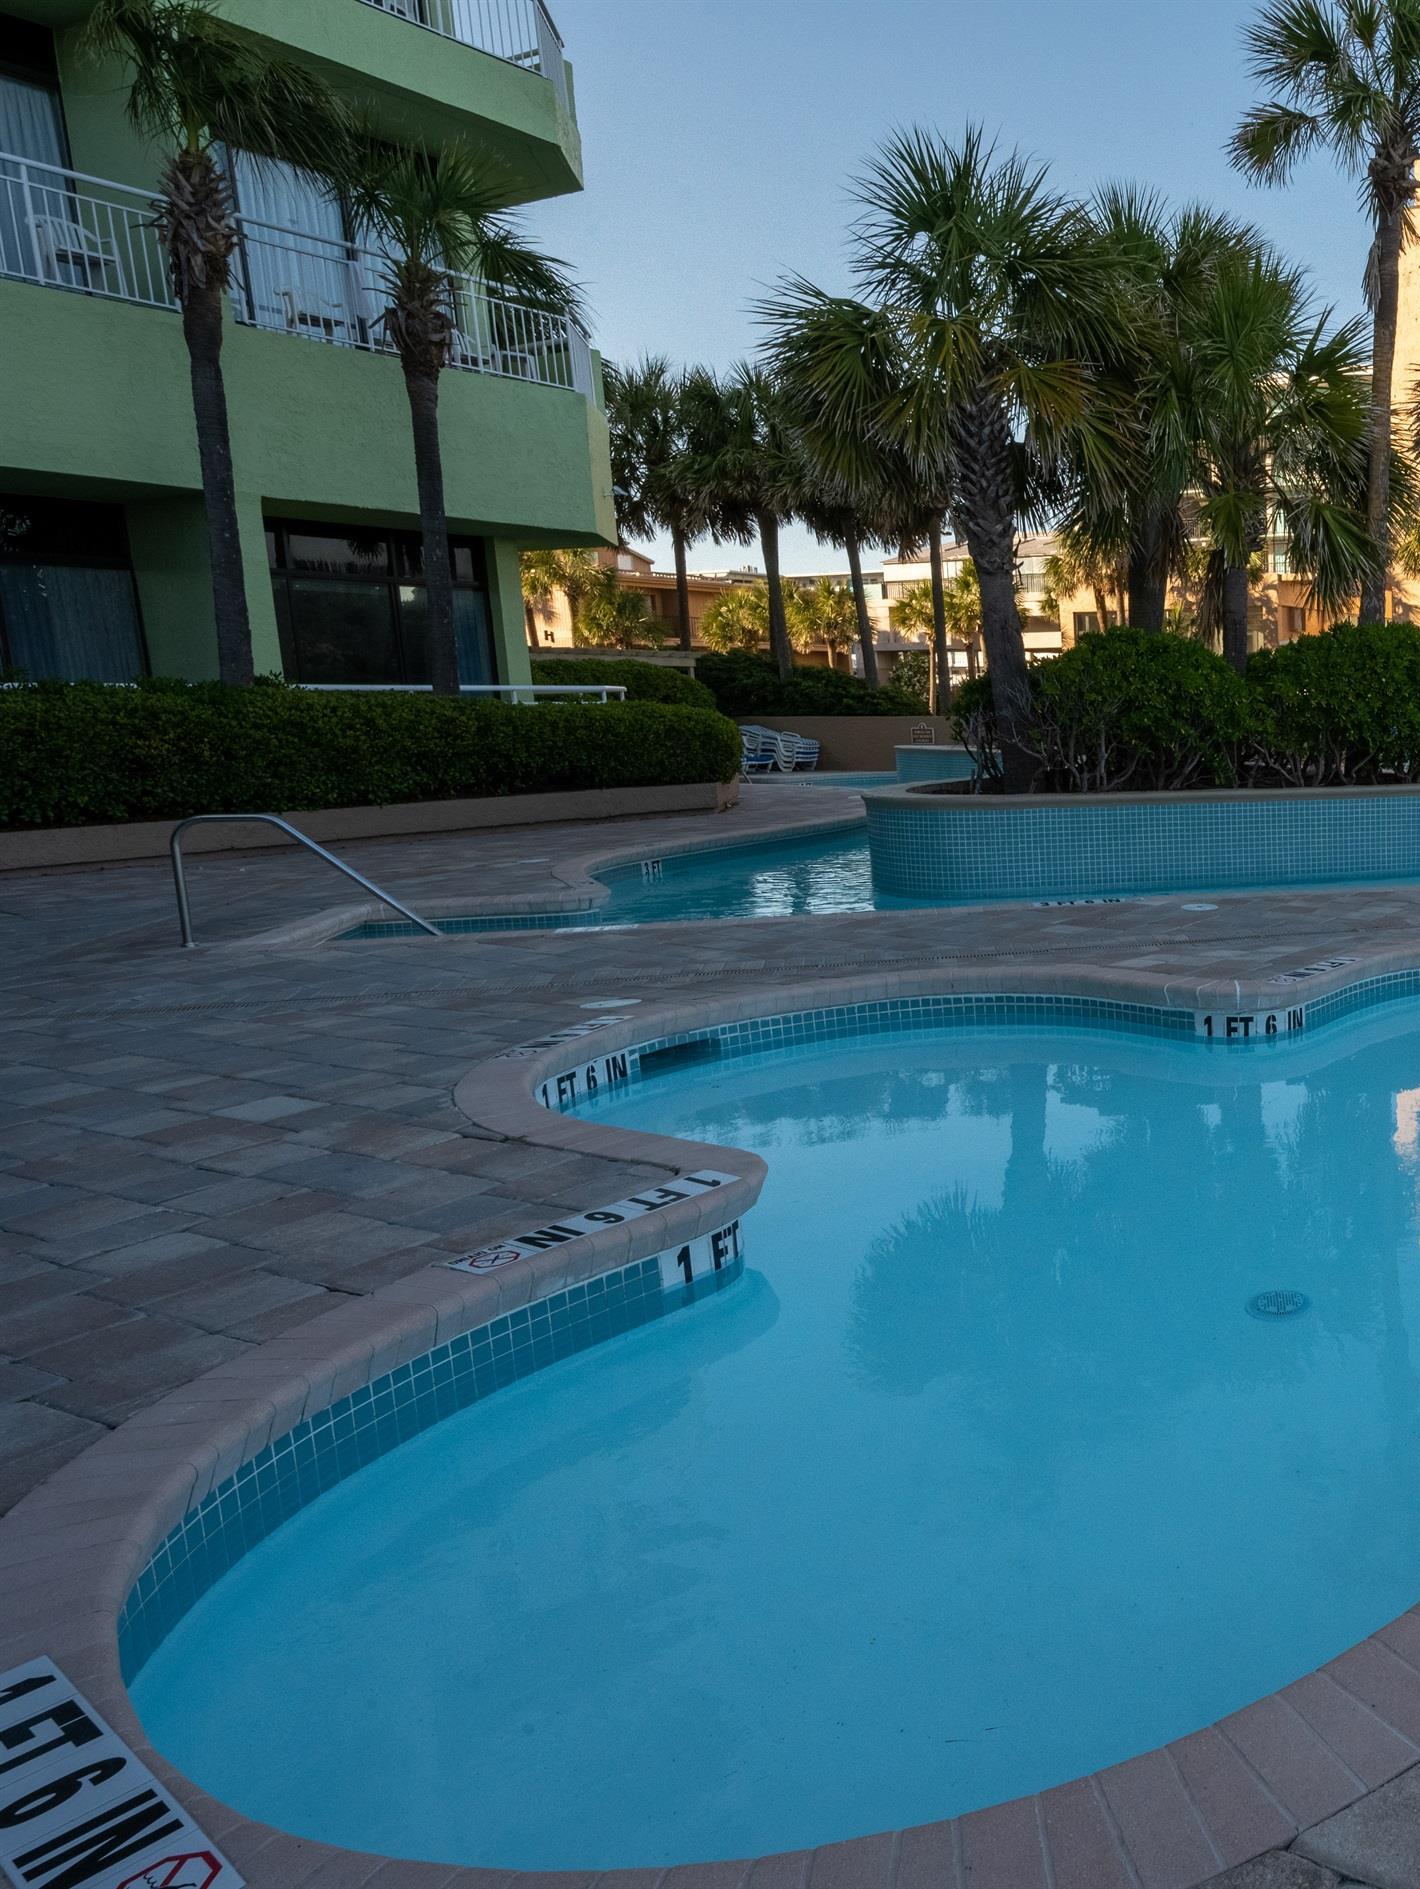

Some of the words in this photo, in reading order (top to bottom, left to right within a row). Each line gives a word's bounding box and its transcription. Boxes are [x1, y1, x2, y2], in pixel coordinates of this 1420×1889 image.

[544, 630, 555, 643] H
[652, 860, 661, 875] FT
[1203, 1015, 1213, 1037] 1
[1226, 1016, 1254, 1037] FT
[1265, 1014, 1278, 1035] 6
[1287, 1007, 1304, 1031] IN
[541, 1083, 550, 1110] 1
[556, 1071, 577, 1105] FT
[586, 1064, 598, 1091] 6
[605, 1053, 628, 1084] IN
[683, 1176, 721, 1187] 1
[627, 1187, 691, 1211] FT
[584, 1211, 625, 1224] 6
[513, 1225, 586, 1249] IN
[676, 1245, 693, 1284] 1
[711, 1219, 739, 1271] FT
[0, 1699, 104, 1775] FT
[0, 1757, 127, 1829] 6
[12, 1788, 185, 1889] IN
